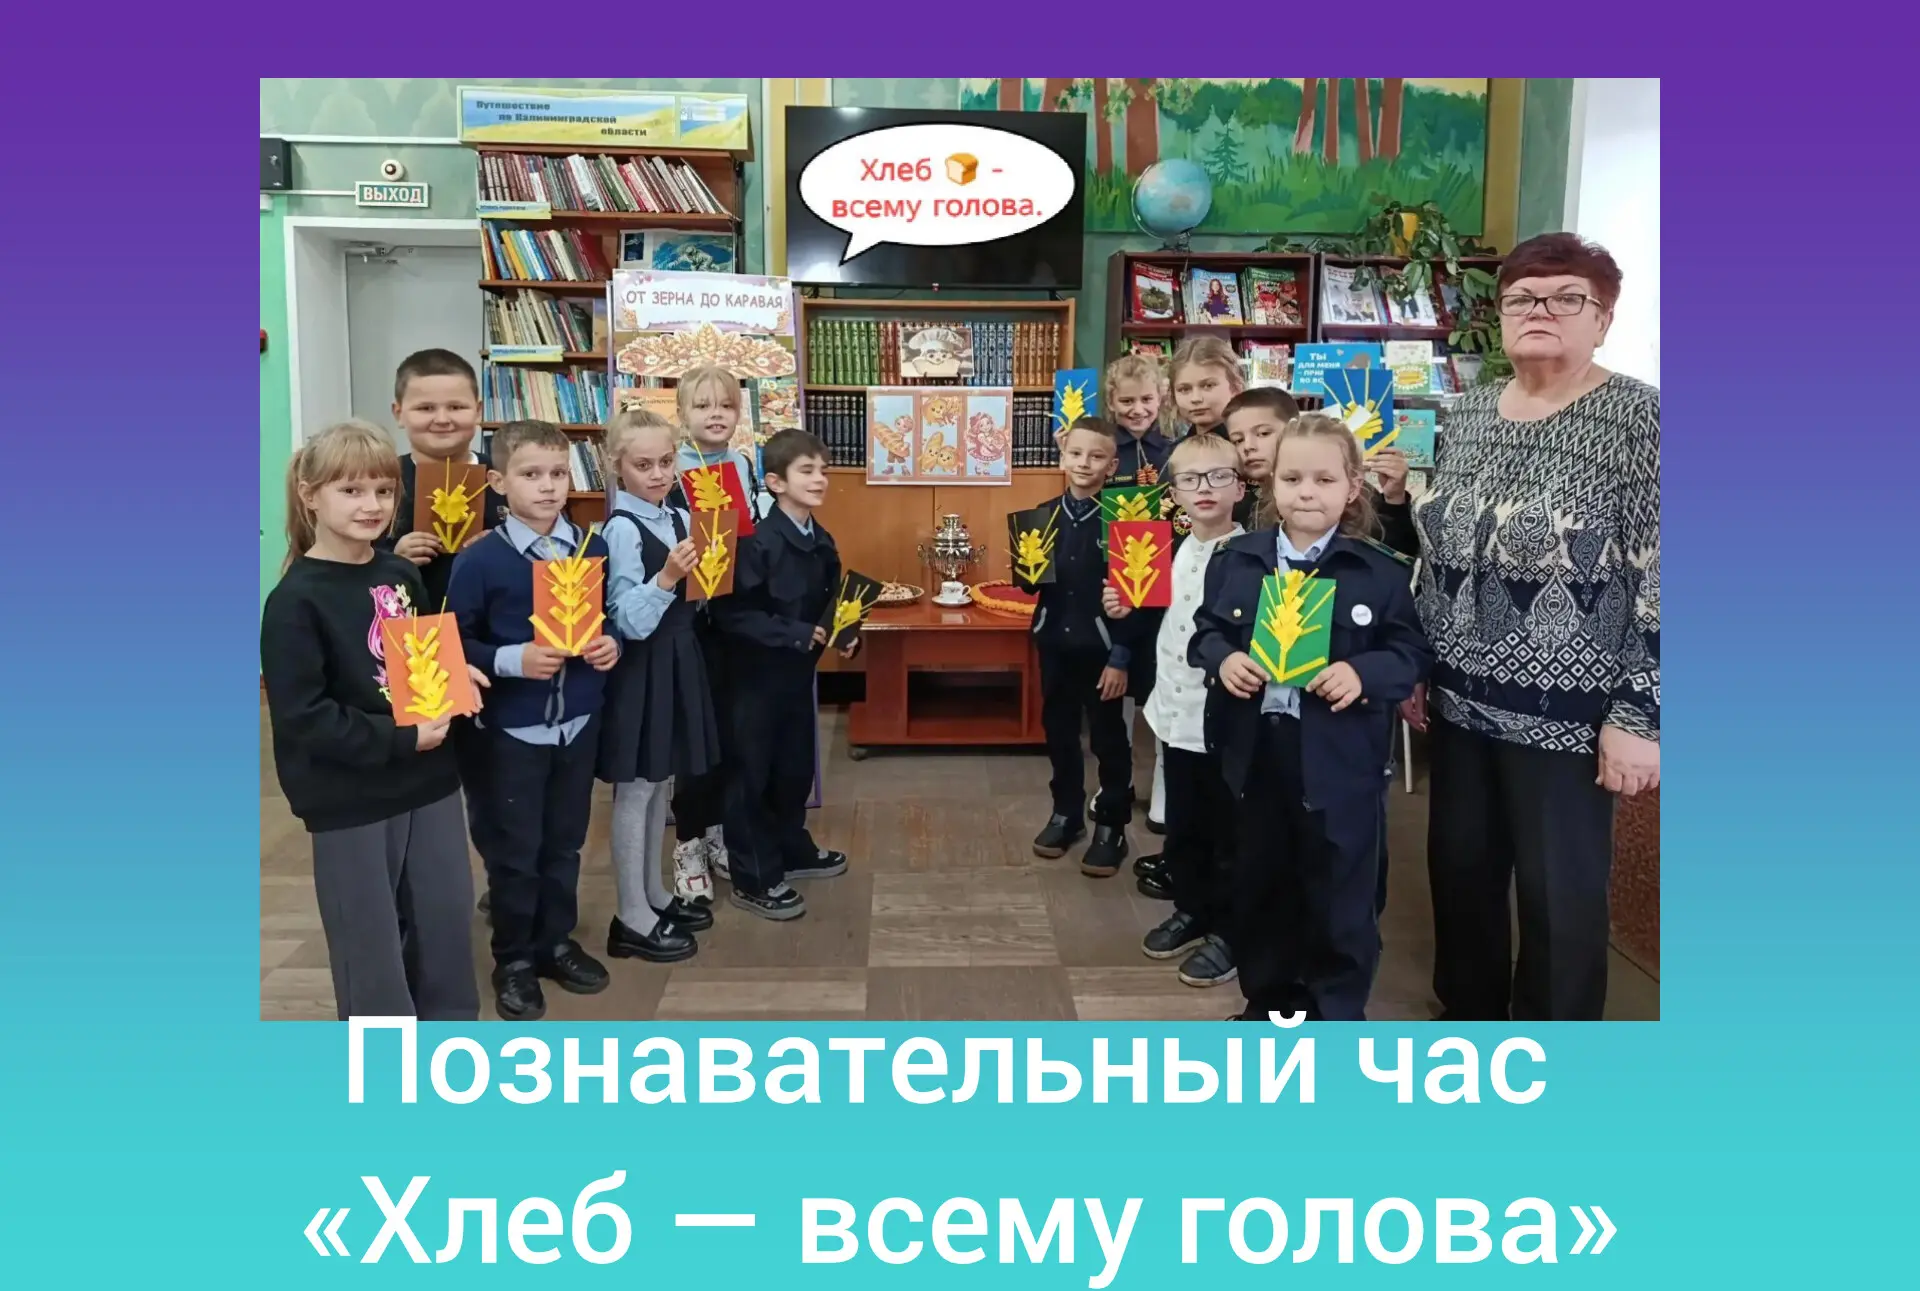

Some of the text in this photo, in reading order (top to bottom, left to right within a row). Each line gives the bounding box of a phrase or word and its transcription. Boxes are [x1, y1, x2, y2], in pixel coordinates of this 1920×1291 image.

[600, 127, 647, 137] области
[363, 186, 422, 203] ВЫХОД
[626, 290, 783, 309] ОТ ЗЕРНА ДО КАРАВАЯ
